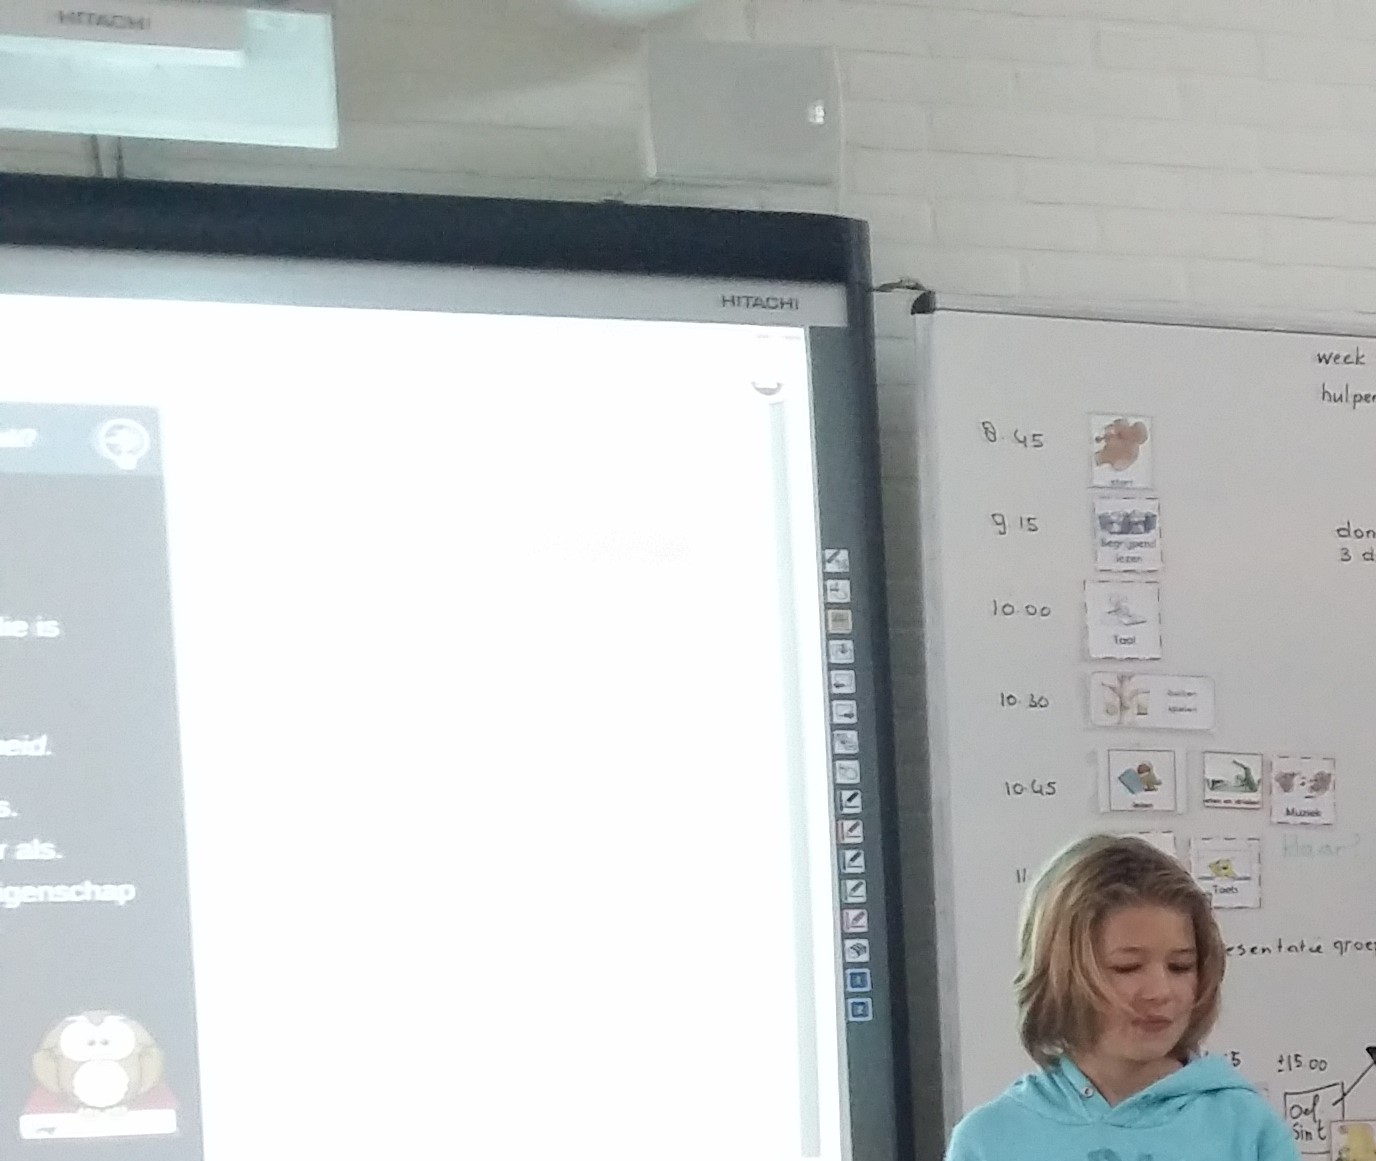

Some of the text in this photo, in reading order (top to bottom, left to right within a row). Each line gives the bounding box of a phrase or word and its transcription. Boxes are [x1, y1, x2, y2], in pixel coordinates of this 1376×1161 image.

[57, 10, 151, 30] HITACHI
[722, 295, 799, 310] HITACHI
[1317, 346, 1366, 366] week
[1340, 548, 1353, 563] 3
[36, 615, 60, 637] is
